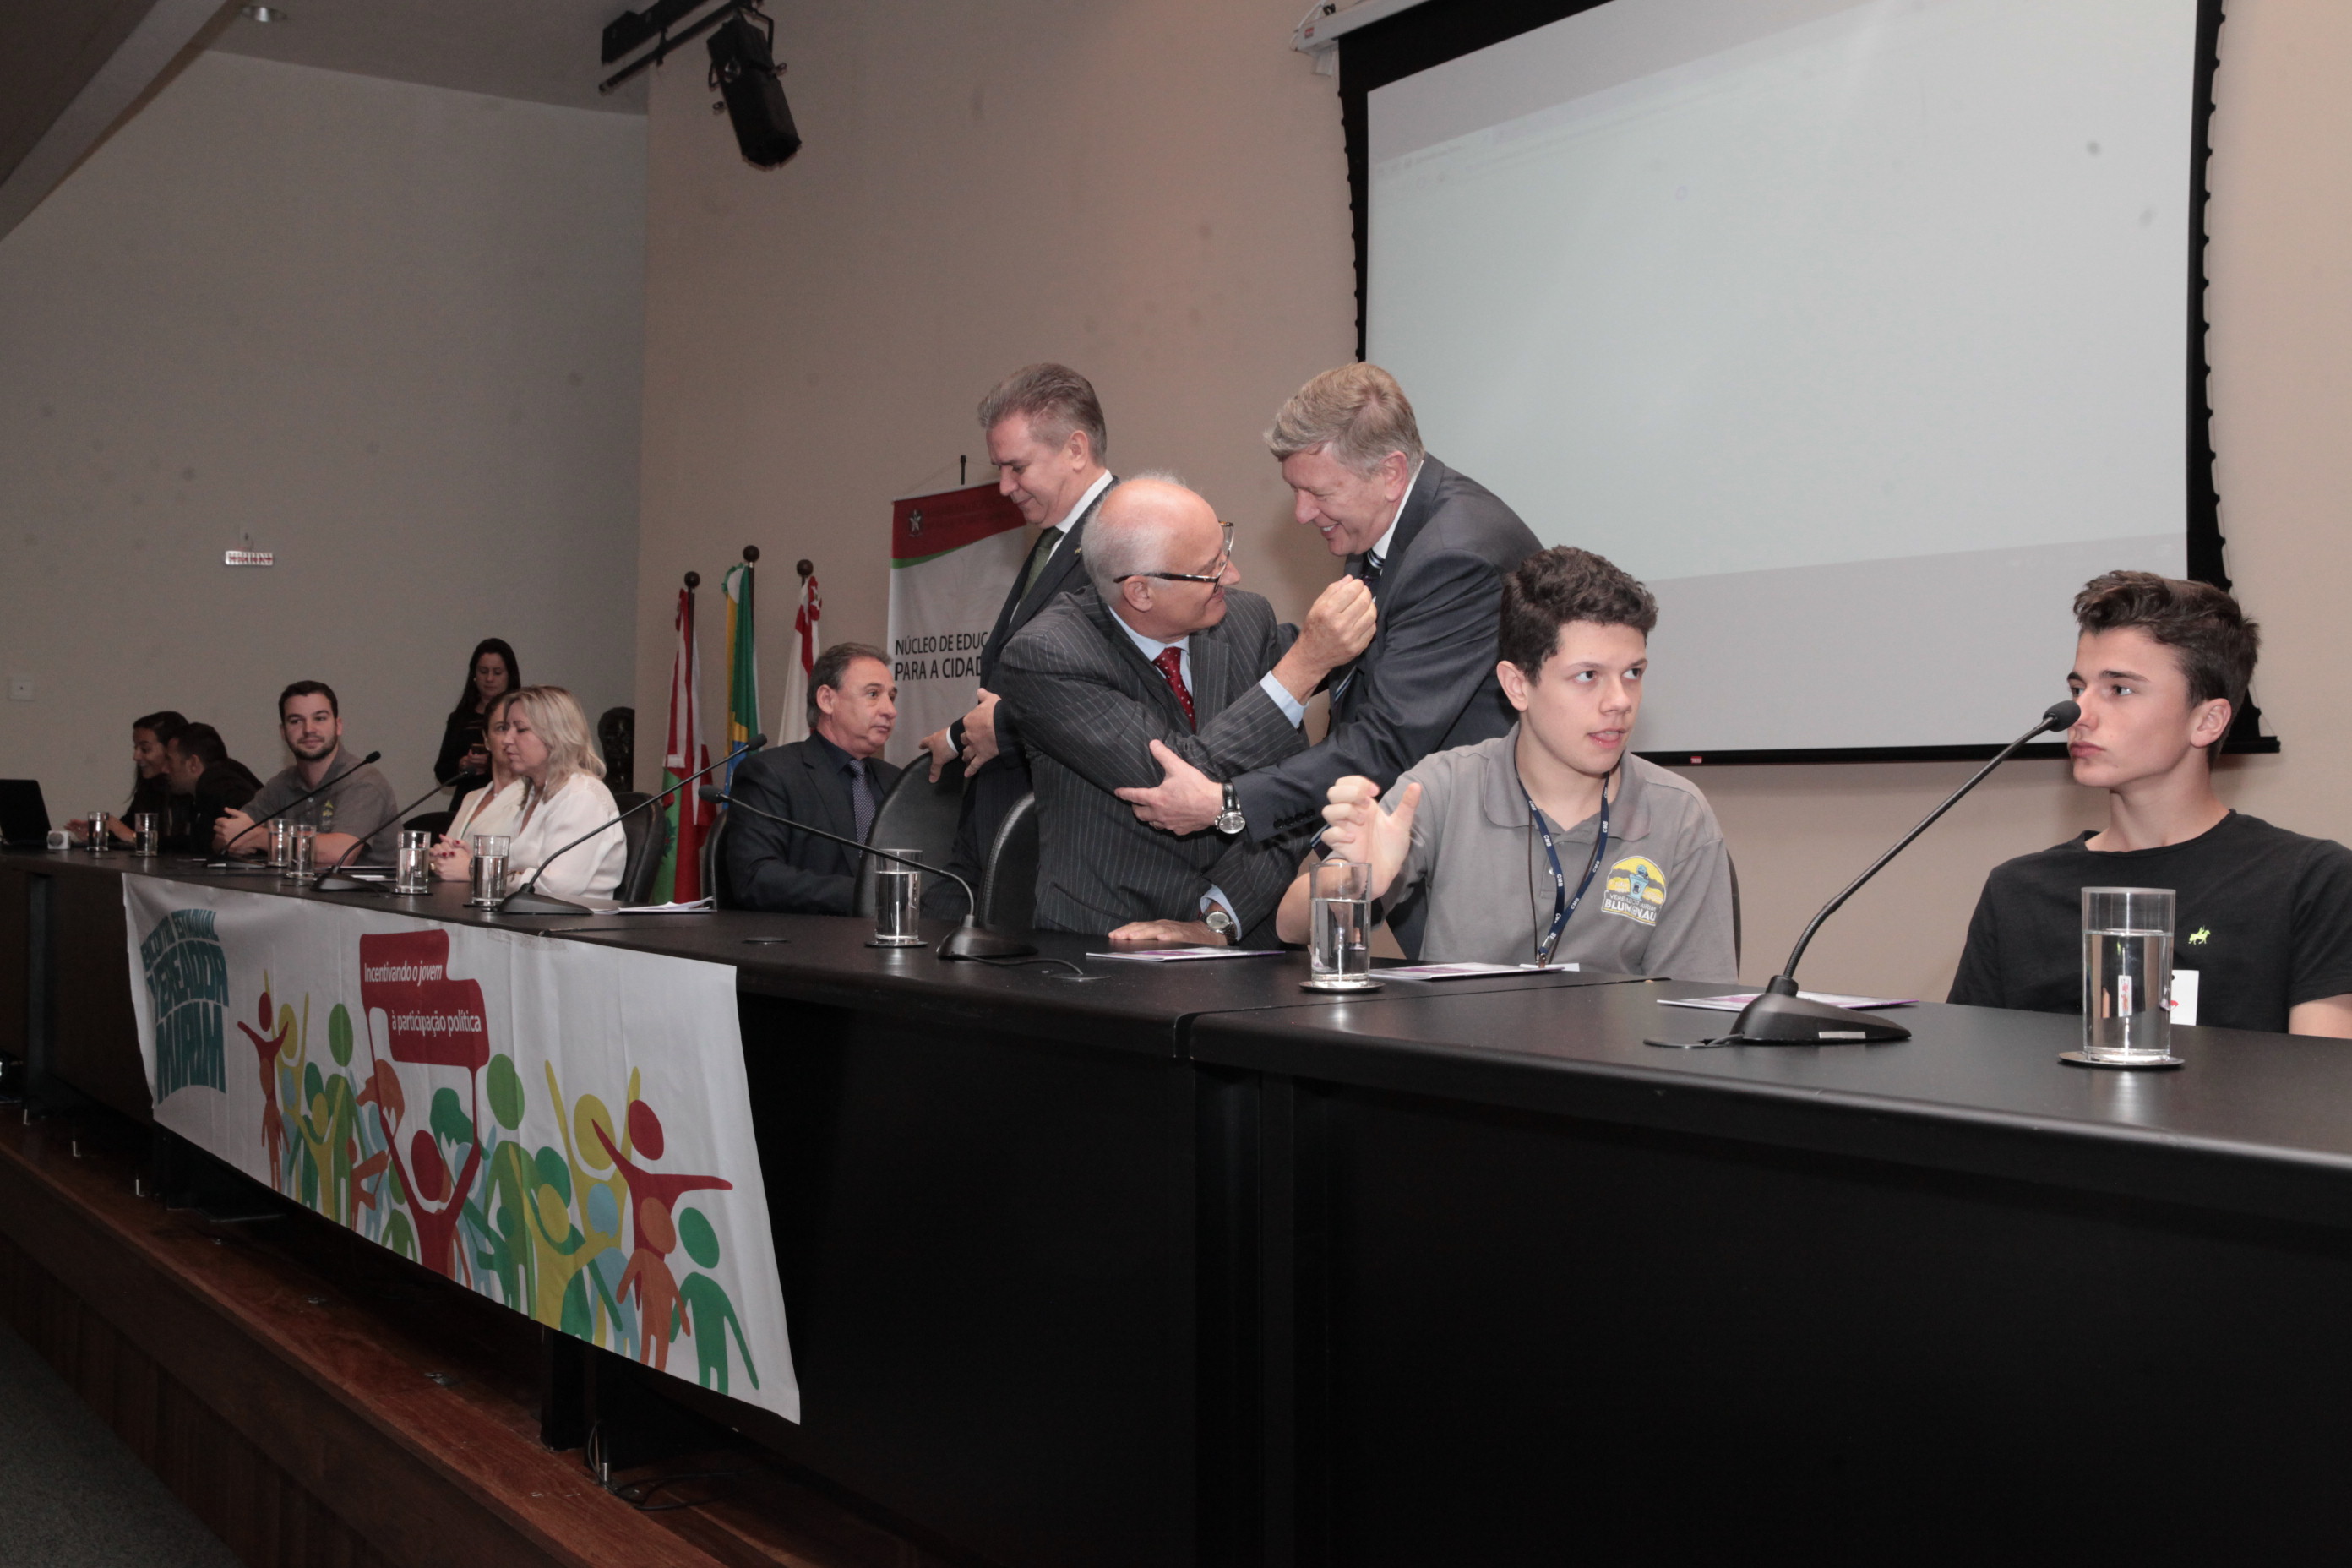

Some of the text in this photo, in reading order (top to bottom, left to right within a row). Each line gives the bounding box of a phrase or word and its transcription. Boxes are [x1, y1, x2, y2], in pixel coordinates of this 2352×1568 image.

[895, 635, 937, 656] NÚCLEO
[939, 635, 954, 652] DE
[894, 661, 927, 681] PARA
[930, 659, 939, 678] A
[146, 940, 230, 1021] VEREADOR
[364, 960, 443, 987] Incentivando o jovem
[391, 1009, 482, 1037] à participação política
[156, 1001, 226, 1105] MIRIM
